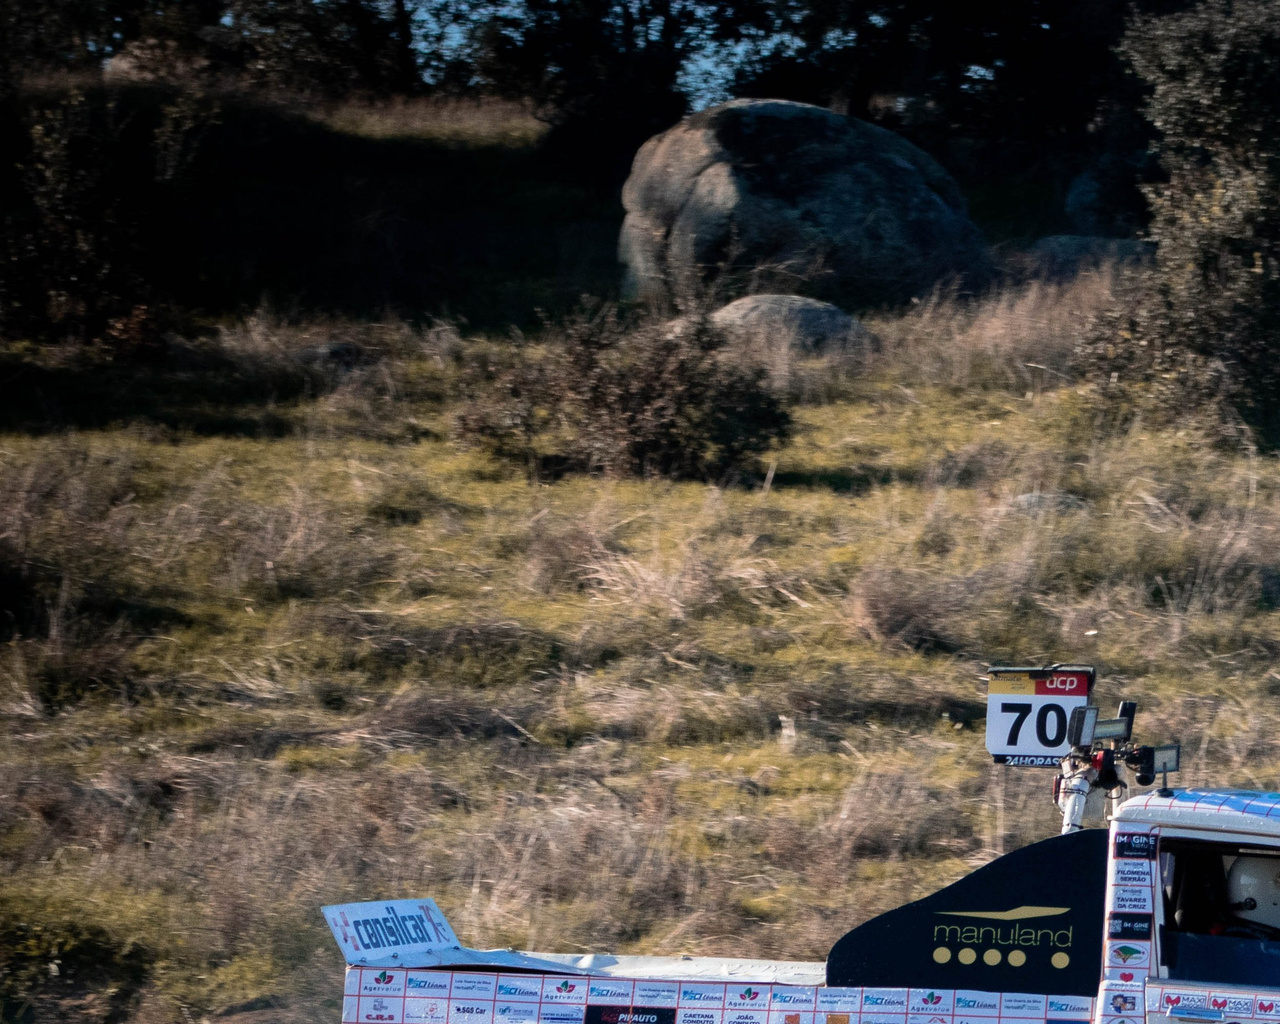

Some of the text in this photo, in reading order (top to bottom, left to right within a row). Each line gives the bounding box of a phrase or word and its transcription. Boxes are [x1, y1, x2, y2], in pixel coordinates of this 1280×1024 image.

[1001, 702, 1068, 748] 70
[353, 907, 432, 950] consilcar
[934, 923, 1073, 948] manuland
[1182, 996, 1206, 1004] MAXI
[1228, 1000, 1251, 1008] MAXI
[476, 1006, 486, 1014] Car
[1070, 1004, 1089, 1012] Léana
